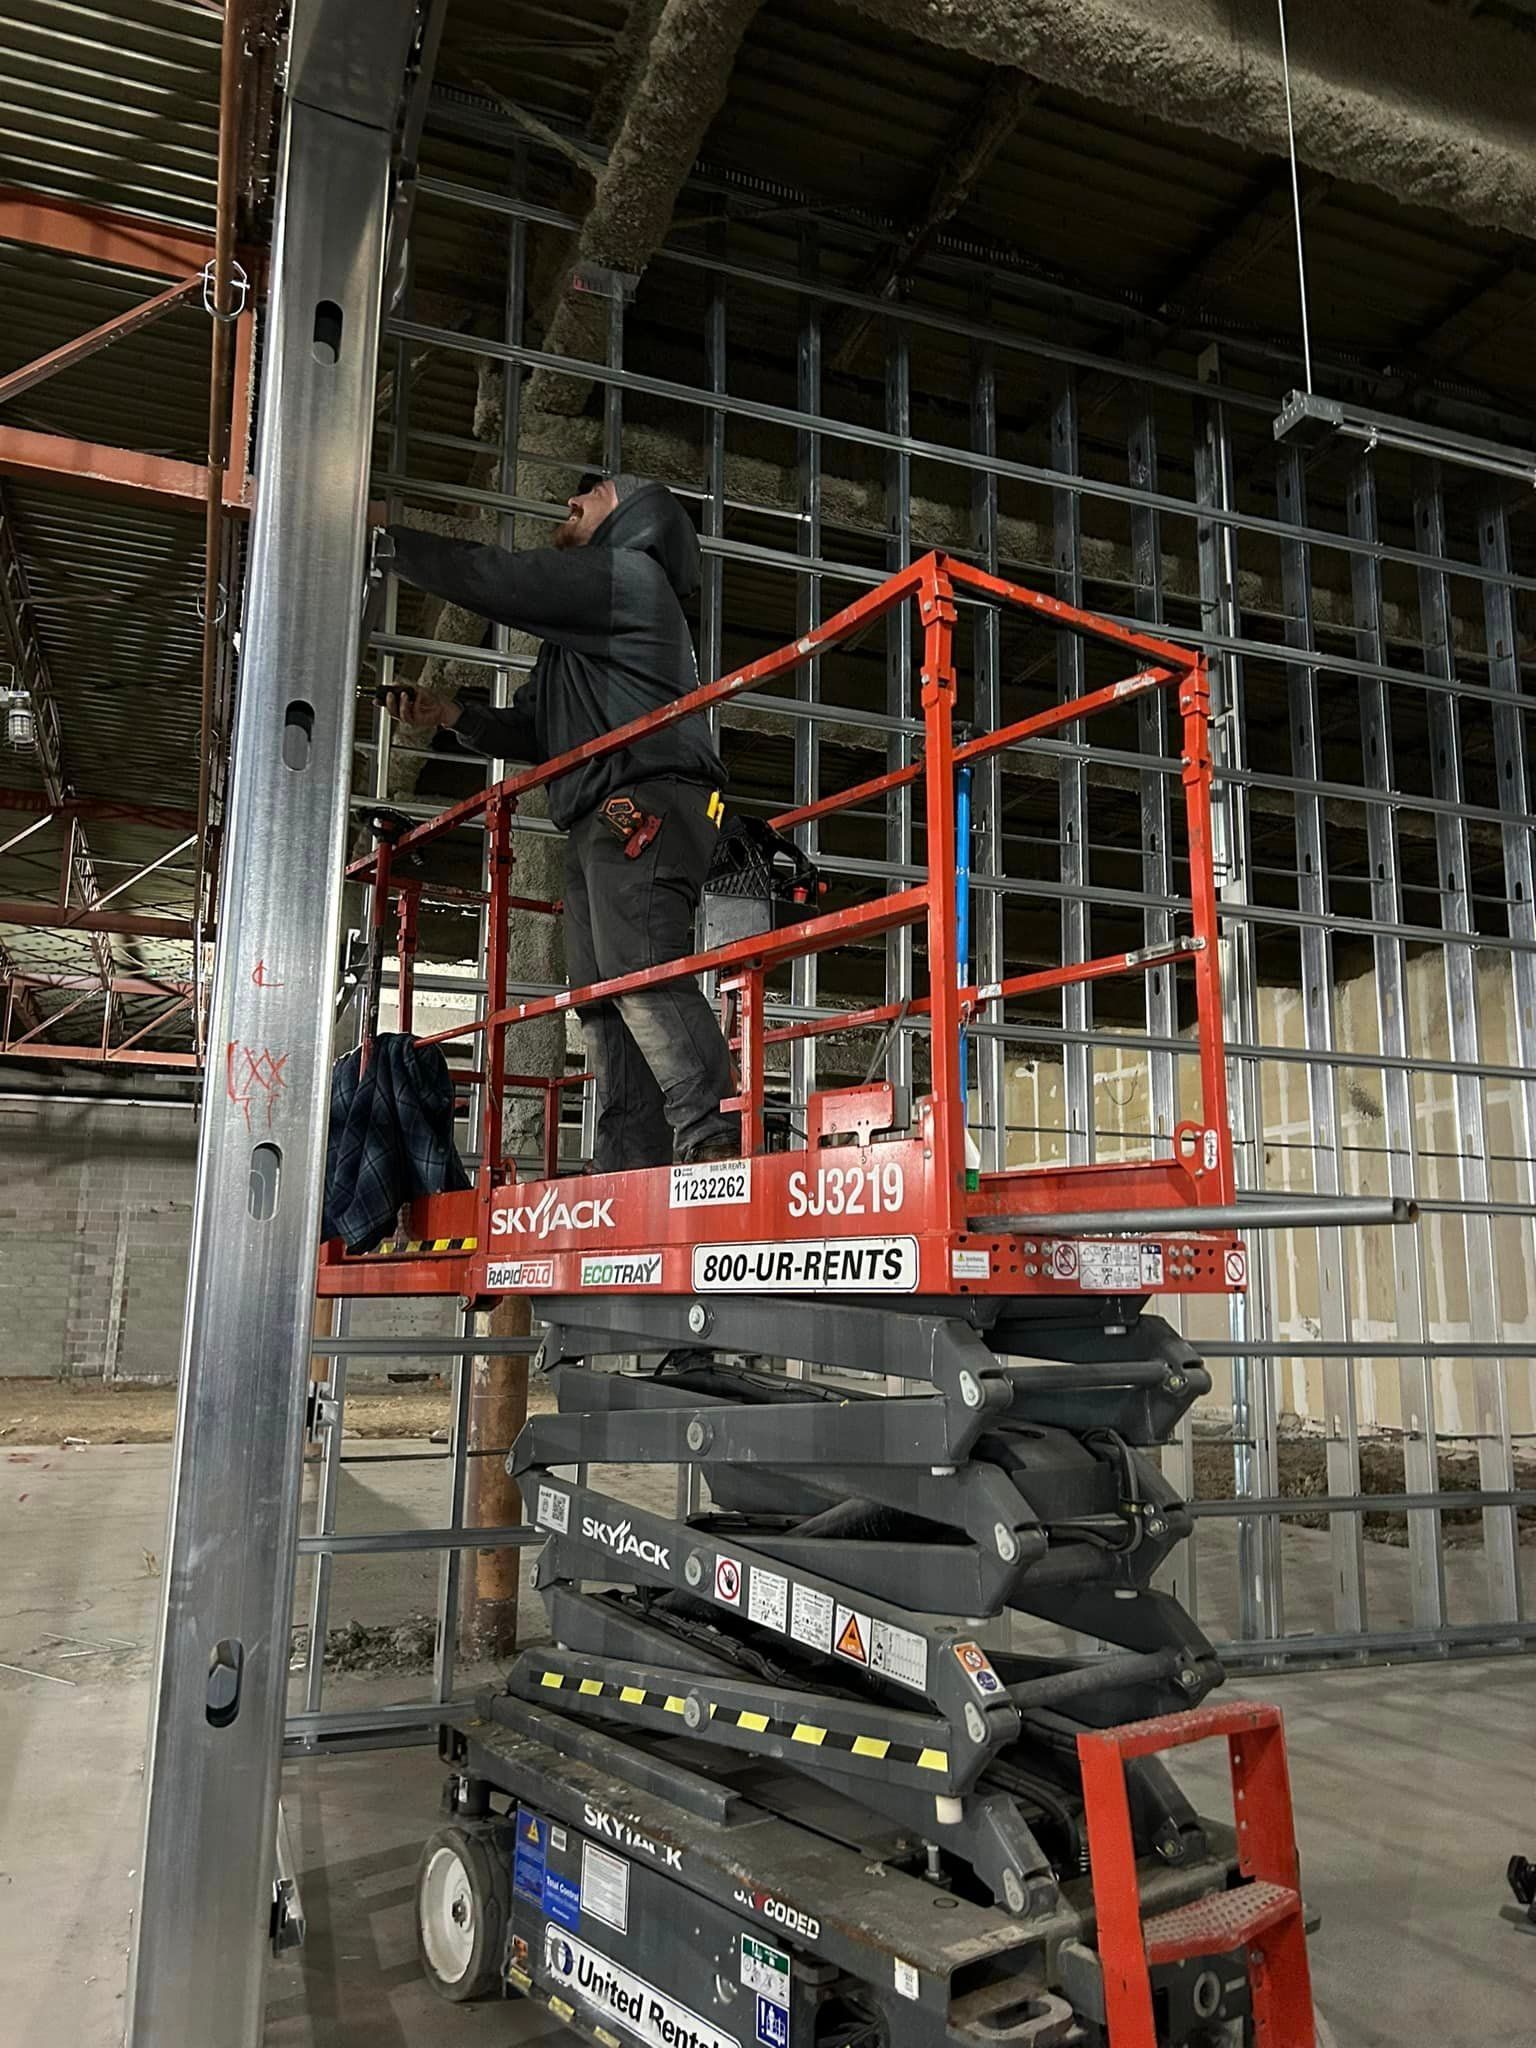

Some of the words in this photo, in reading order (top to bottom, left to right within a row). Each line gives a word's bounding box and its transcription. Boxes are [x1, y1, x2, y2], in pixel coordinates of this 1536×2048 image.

[490, 1186, 616, 1240] SKYJACK
[674, 1175, 745, 1202] 11232262
[788, 1162, 904, 1218] SJ3219
[582, 1256, 661, 1284] ECOTRAY
[703, 1247, 903, 1283] 800-UR-RENTS
[581, 1516, 671, 1571] SKYJACK
[577, 1954, 644, 2024] United
